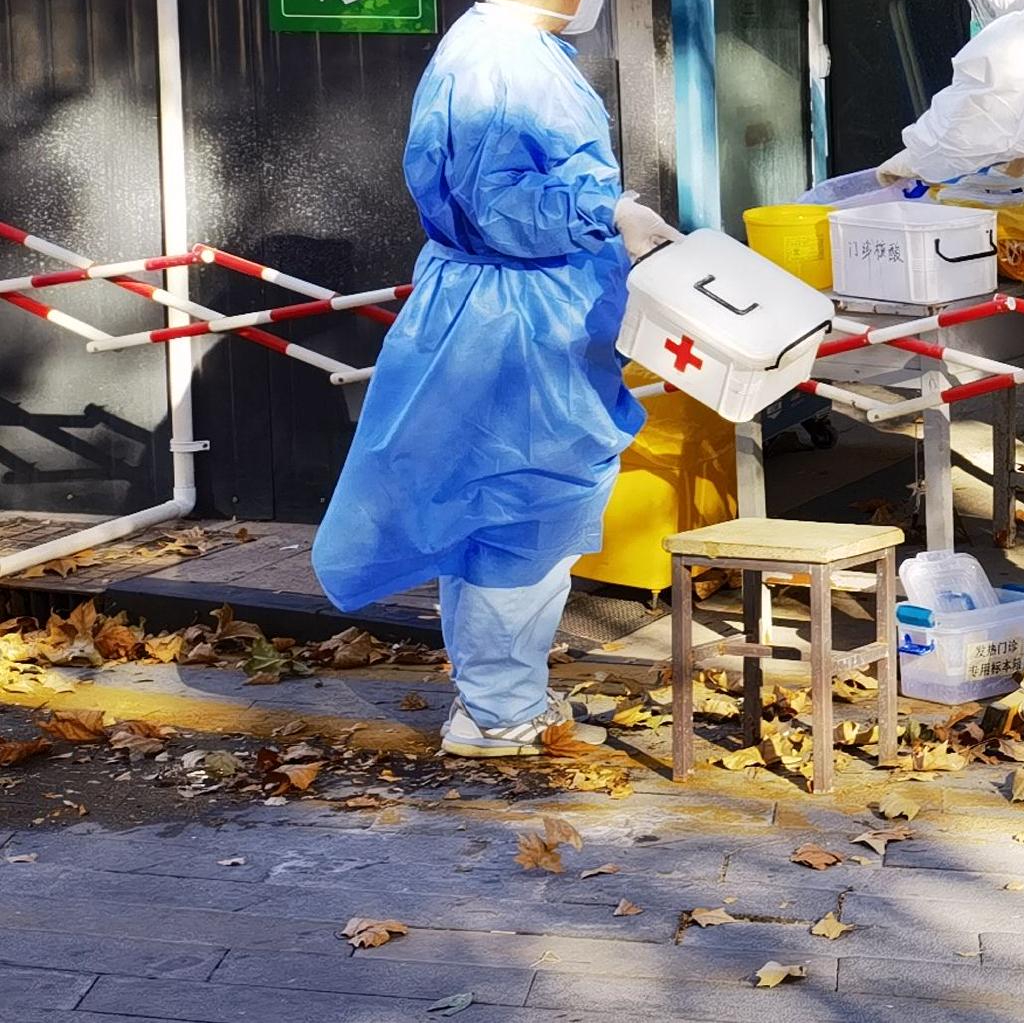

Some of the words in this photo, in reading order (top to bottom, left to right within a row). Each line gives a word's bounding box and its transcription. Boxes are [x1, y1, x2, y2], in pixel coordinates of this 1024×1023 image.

[848, 239, 904, 263] 门诊核酸
[976, 639, 1018, 657] 发热门诊
